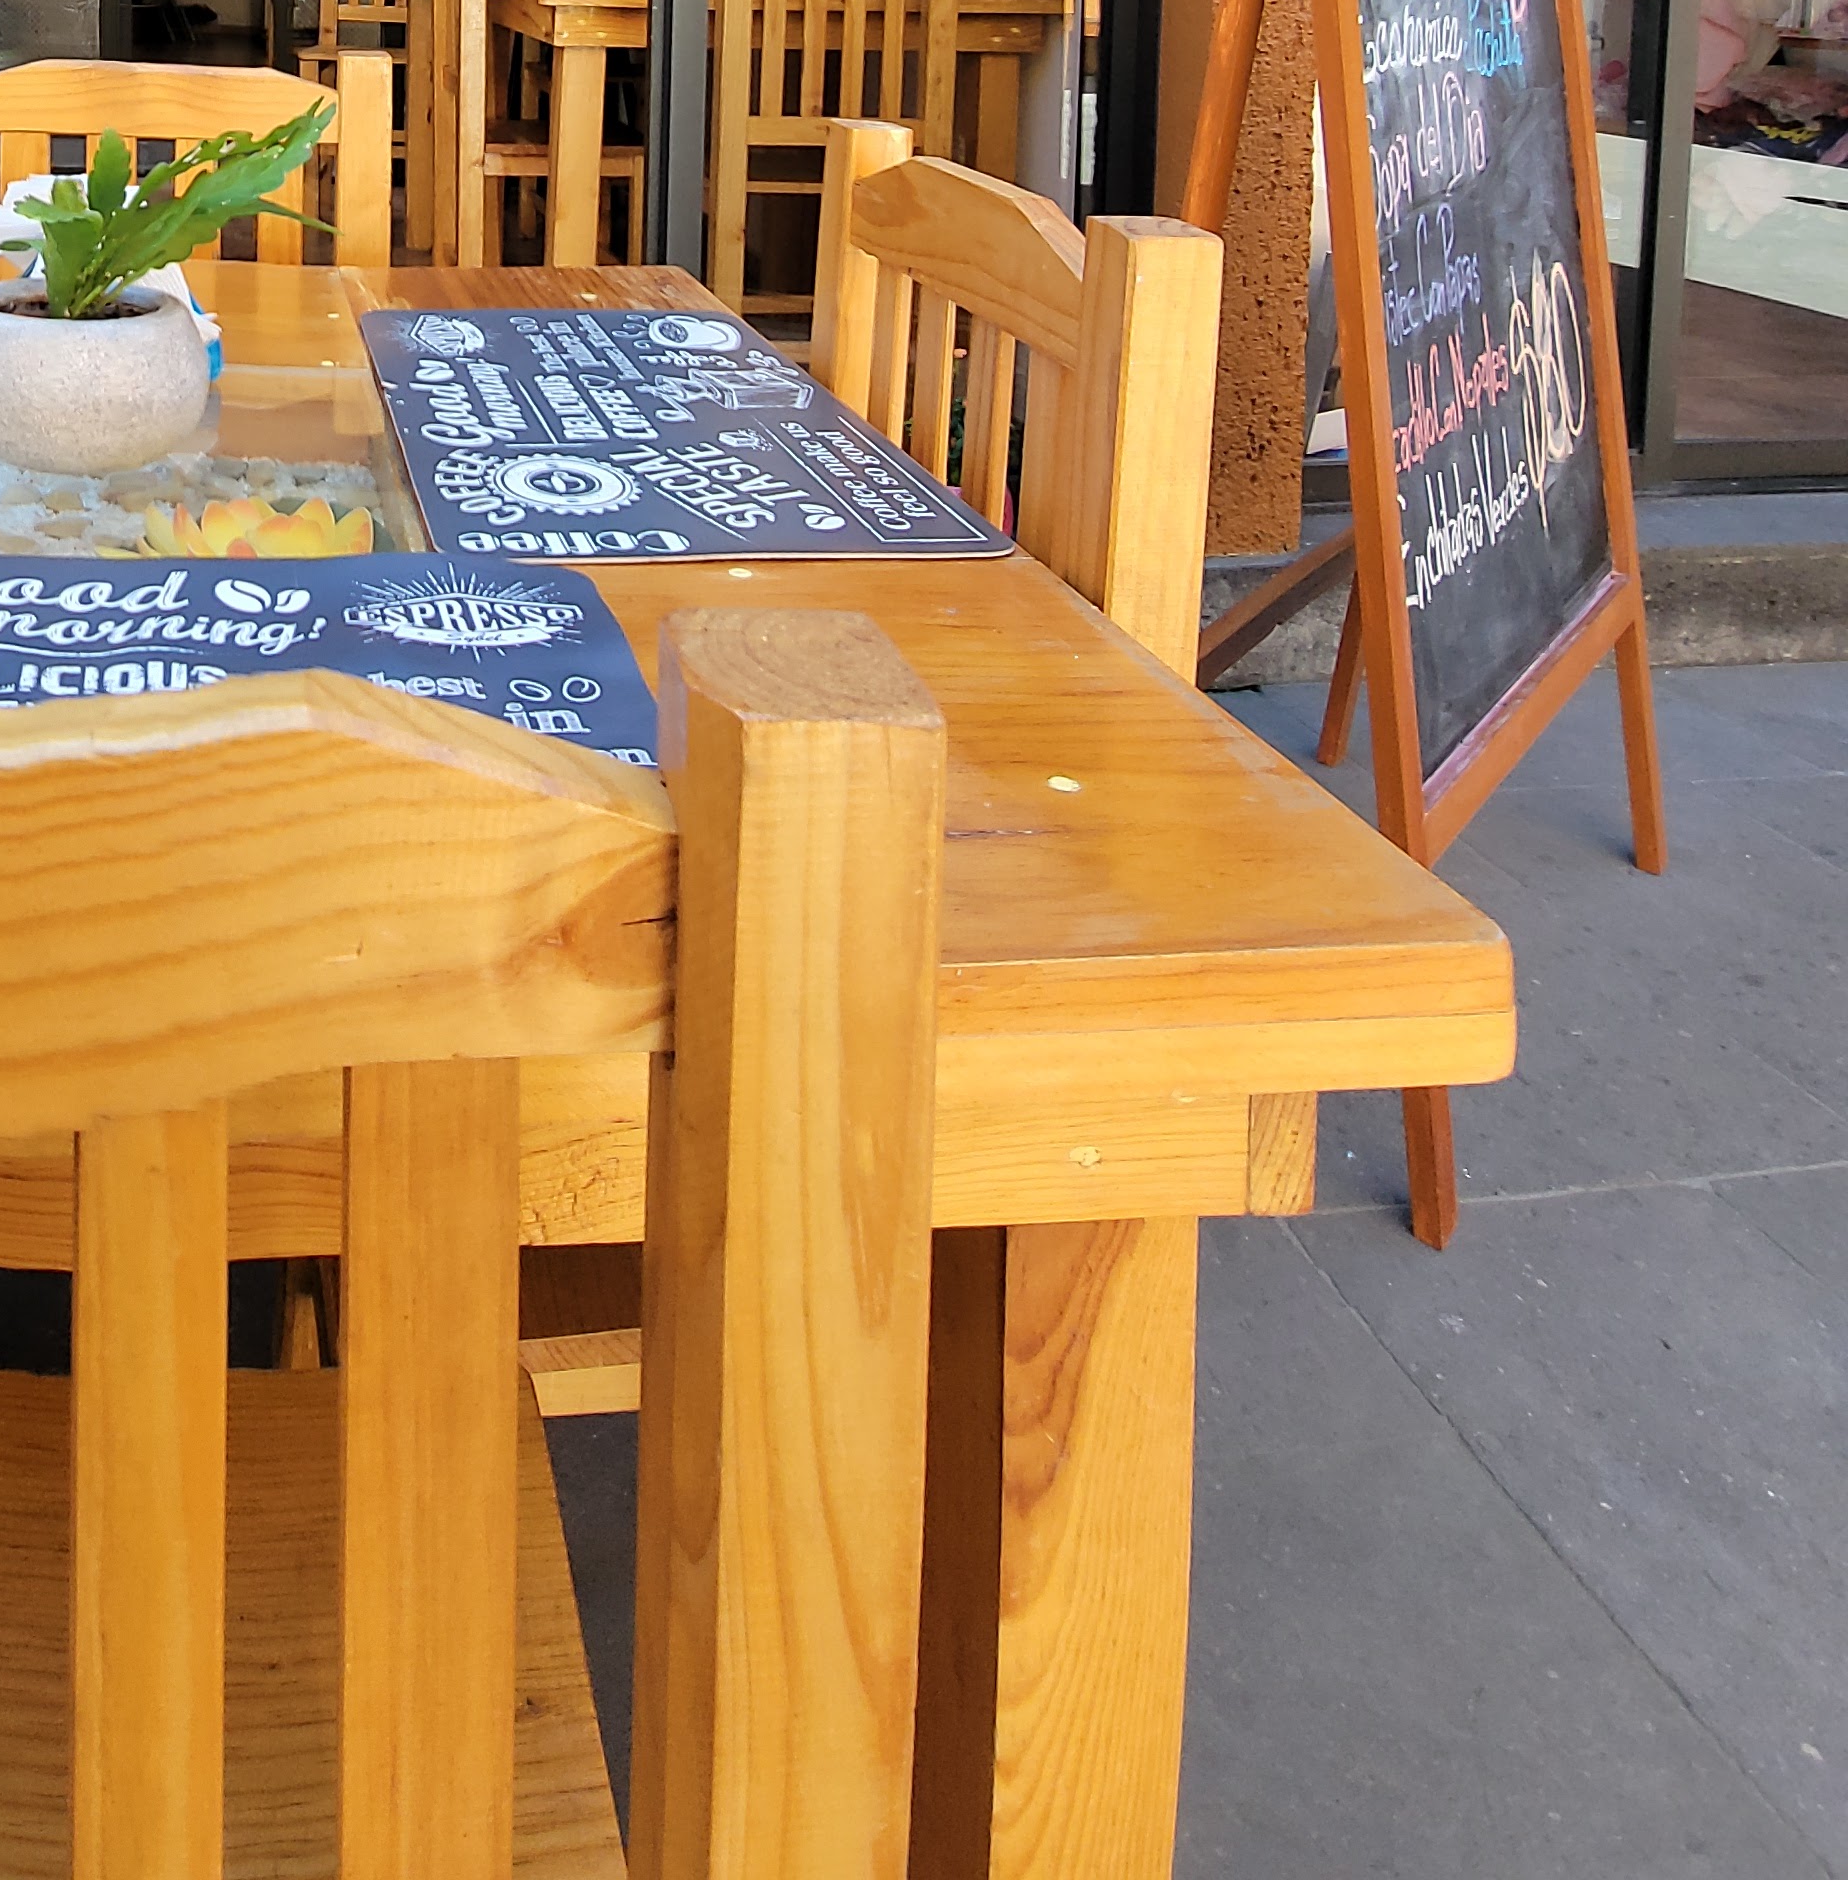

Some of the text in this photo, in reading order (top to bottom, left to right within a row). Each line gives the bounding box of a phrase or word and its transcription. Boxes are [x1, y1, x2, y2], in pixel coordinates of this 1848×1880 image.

[421, 382, 514, 446] Good
[534, 375, 608, 438] DELICIOUS
[585, 389, 662, 439] COFFEE
[801, 441, 856, 478] make
[815, 431, 880, 465] good
[611, 444, 777, 528] SPECIAL
[672, 441, 811, 506] TASTE
[844, 480, 911, 530] Coffee
[880, 489, 937, 517] feel
[355, 599, 575, 633] ESPRESSO
